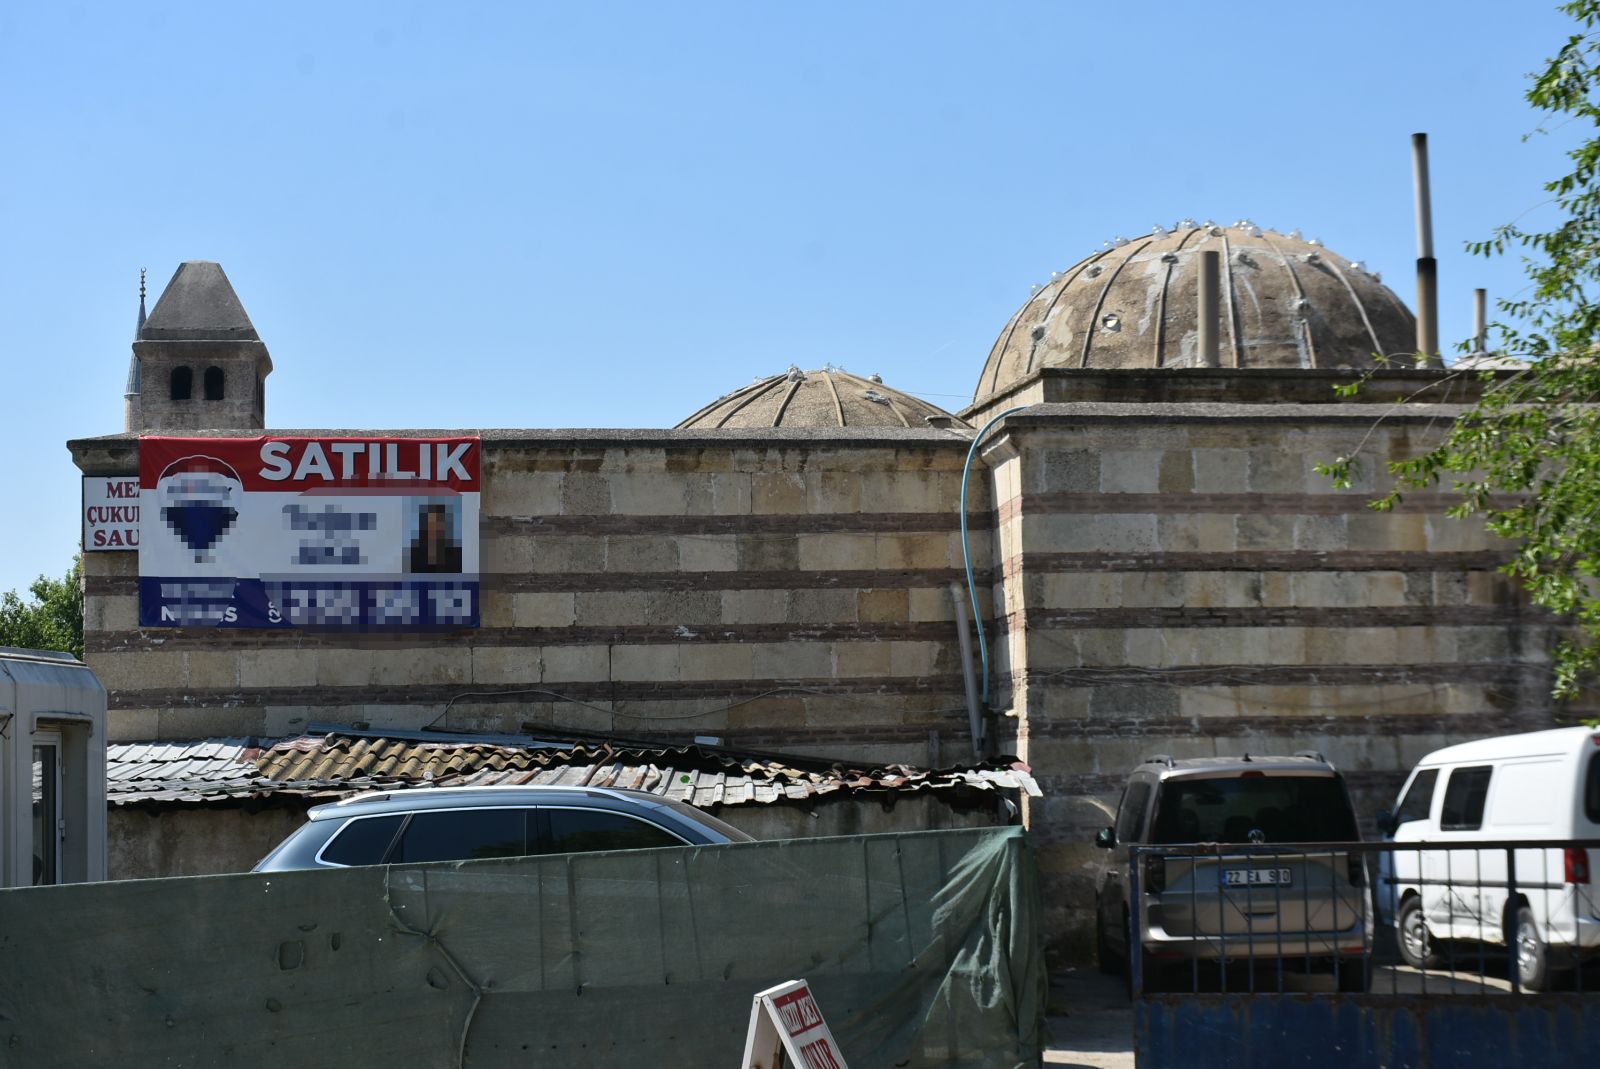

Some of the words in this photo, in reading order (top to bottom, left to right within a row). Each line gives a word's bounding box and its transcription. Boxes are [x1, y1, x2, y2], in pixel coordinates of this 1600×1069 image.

[258, 441, 473, 481] SATILIK
[87, 506, 140, 527] ÇUKU
[1228, 872, 1241, 883] 22
[1269, 870, 1290, 882] 90
